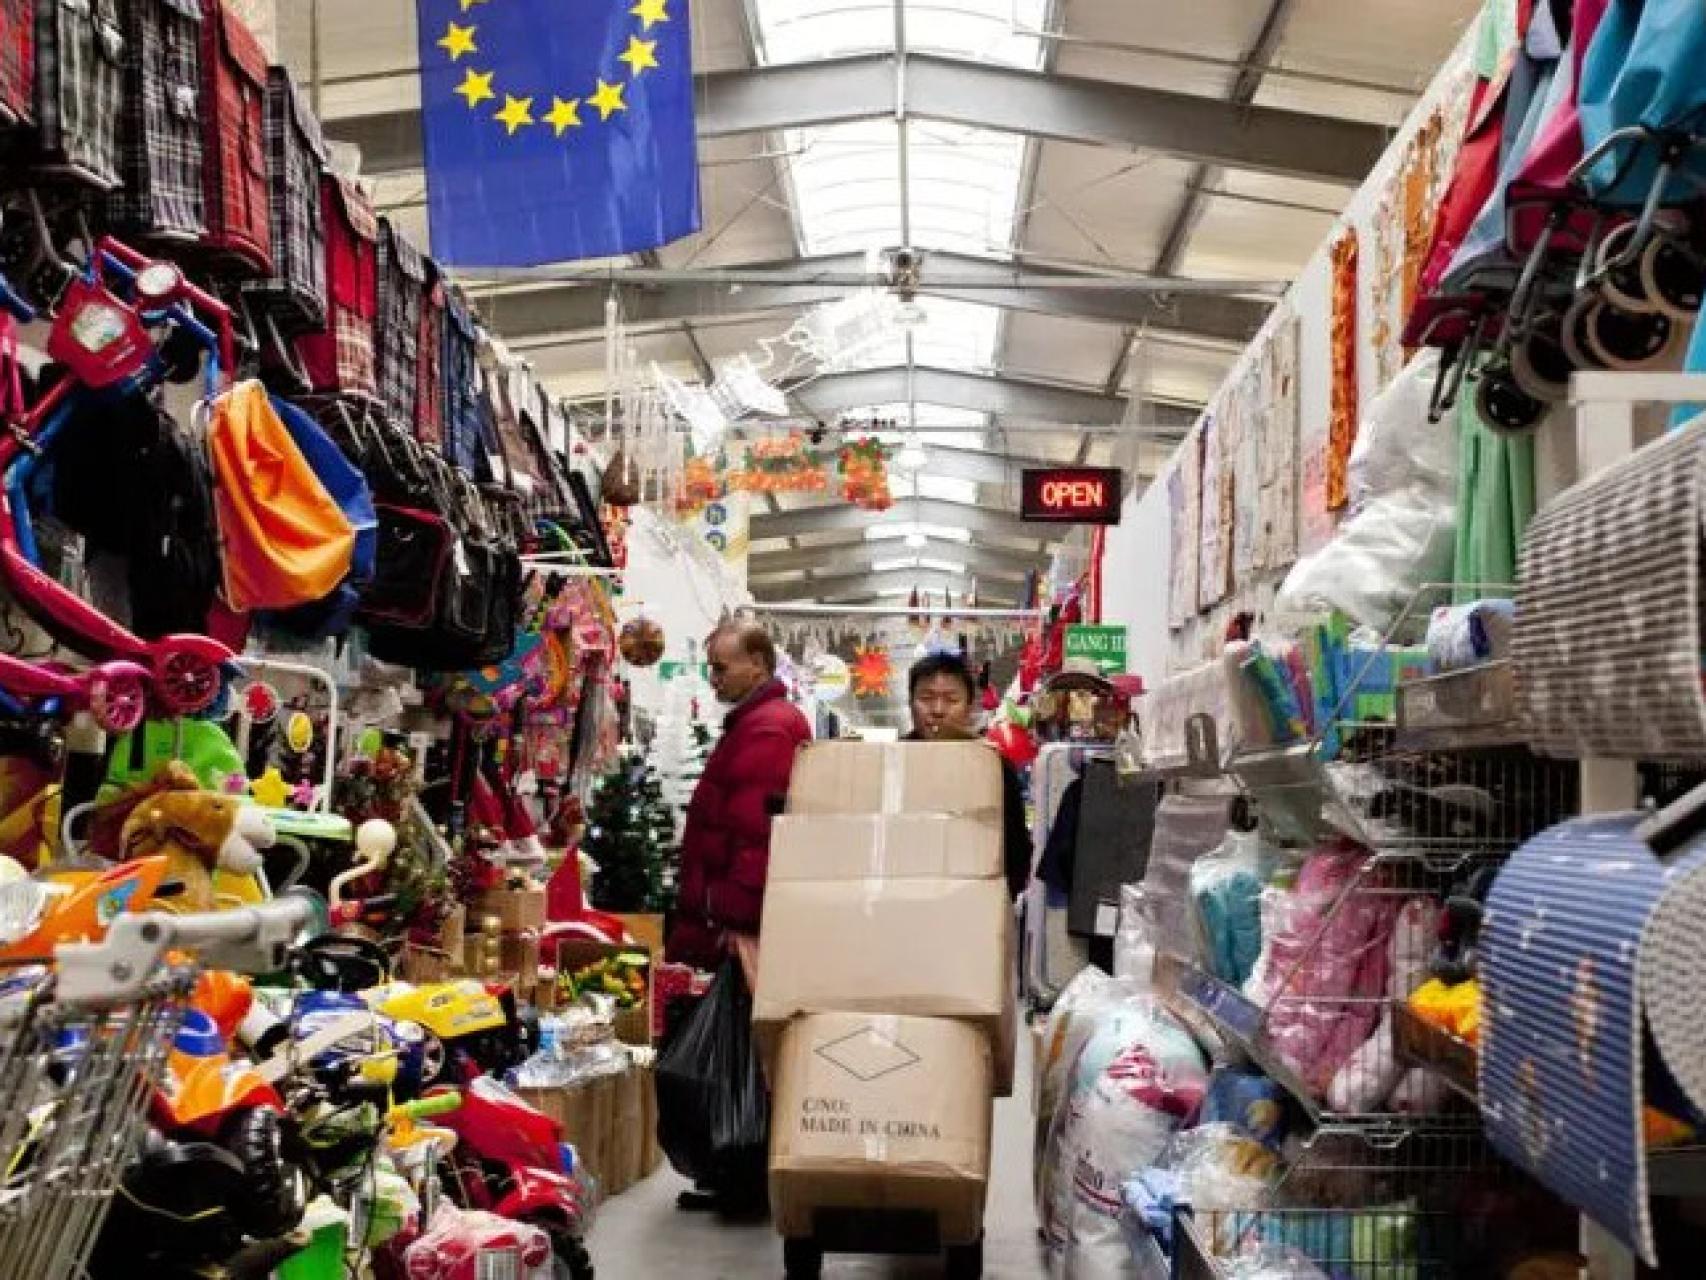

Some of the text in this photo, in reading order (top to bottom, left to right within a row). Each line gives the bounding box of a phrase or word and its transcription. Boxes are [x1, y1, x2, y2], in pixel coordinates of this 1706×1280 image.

[1042, 481, 1103, 508] OPEN
[1066, 633, 1109, 650] GANG
[800, 1117, 941, 1138] MADE IN CHINA
